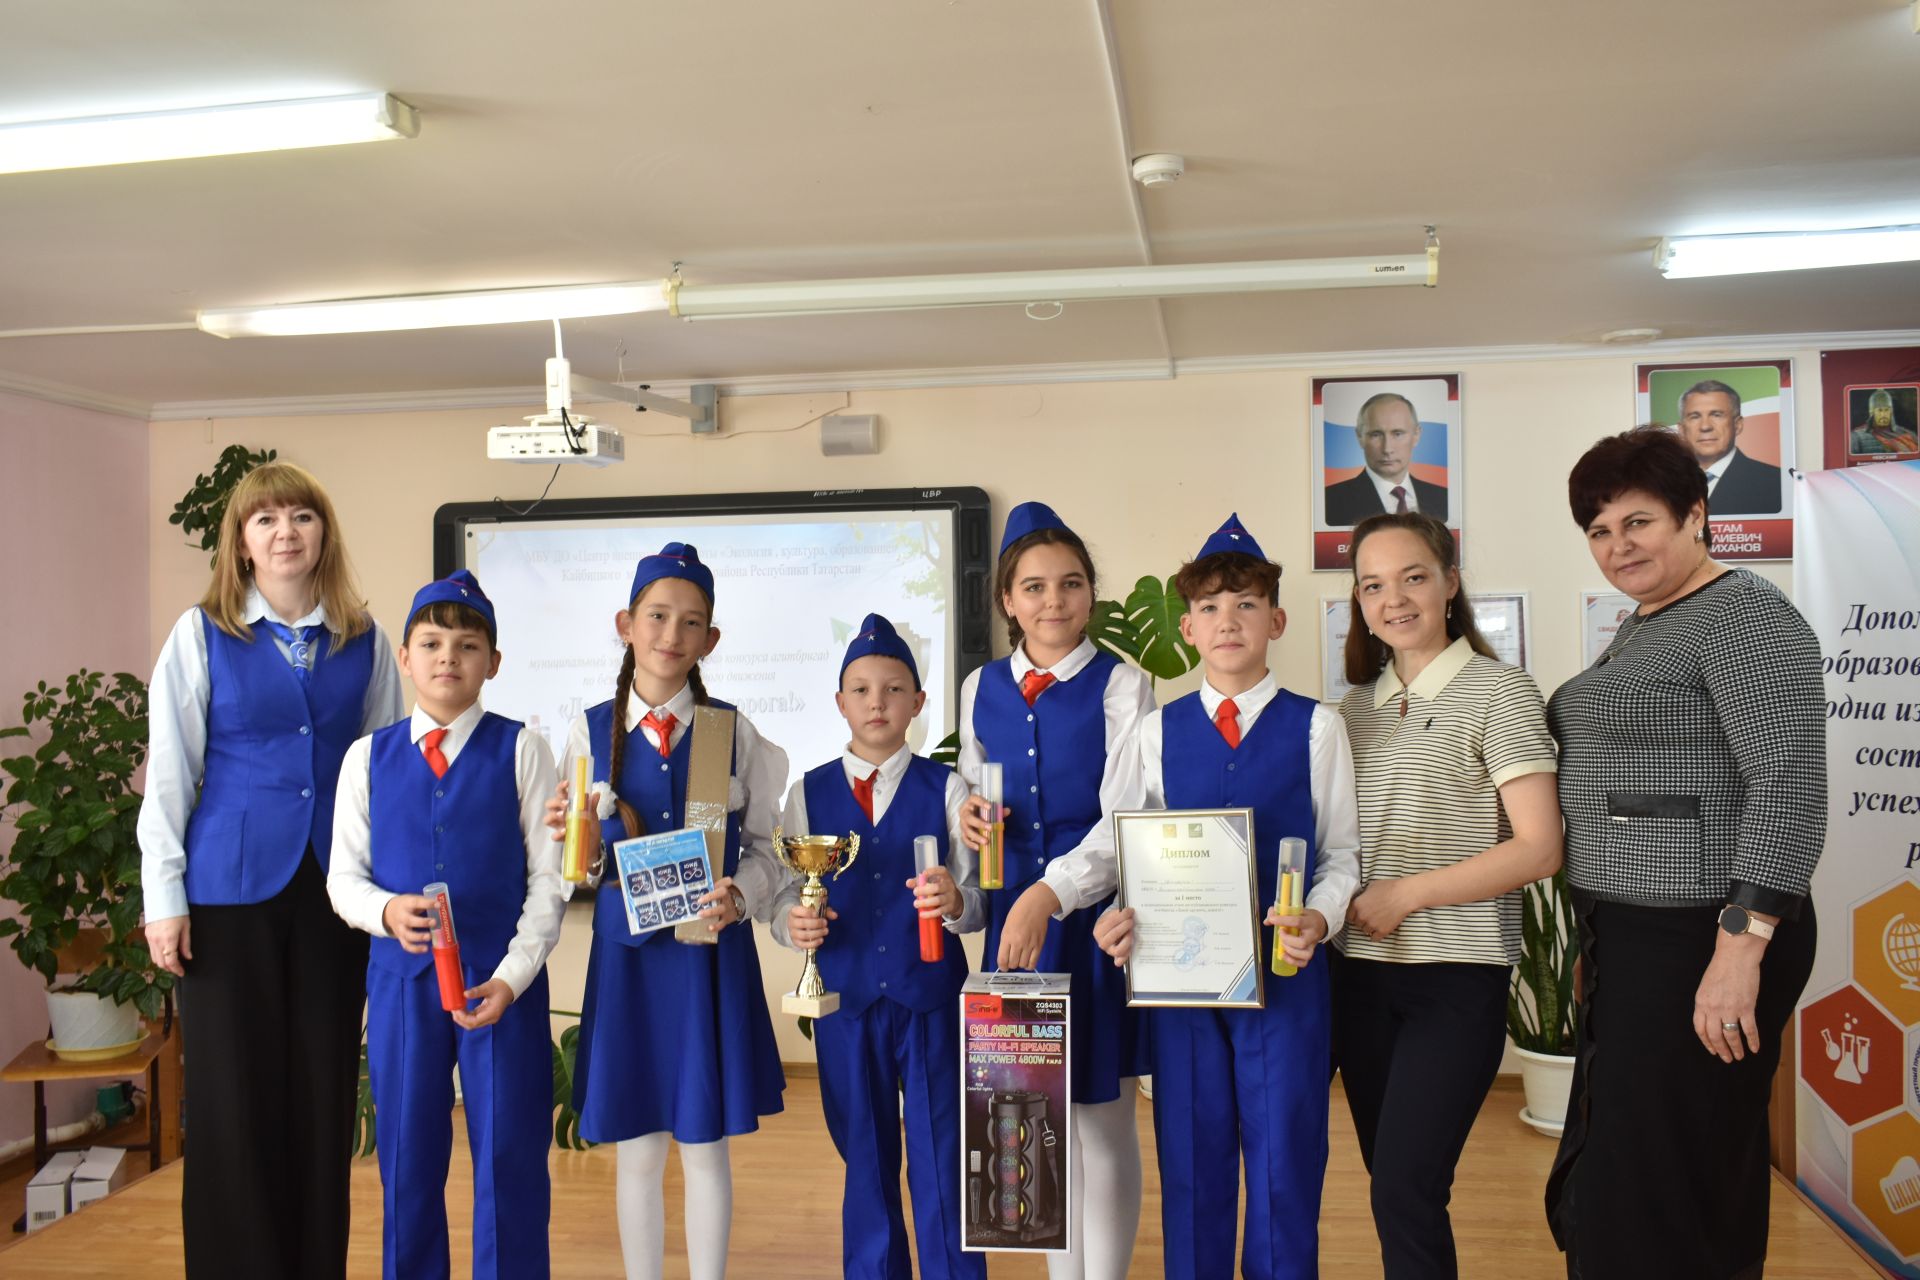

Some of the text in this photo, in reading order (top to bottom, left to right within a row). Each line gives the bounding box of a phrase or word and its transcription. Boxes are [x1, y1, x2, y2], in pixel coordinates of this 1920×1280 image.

[922, 489, 942, 498] ЦВР
[1710, 523, 1743, 533] СТАМ
[1712, 533, 1762, 543] ЛИЕВИЧ
[1710, 542, 1762, 552] ИХАНОВ
[1826, 693, 1887, 721] одна
[1160, 847, 1210, 860] Диплом
[969, 1024, 1063, 1038] COLORFUL BASS
[969, 1041, 997, 1051] PARTY
[1020, 1042, 1061, 1052] SPEAKER
[969, 1055, 987, 1064] MAX
[988, 1055, 1017, 1064] POWER
